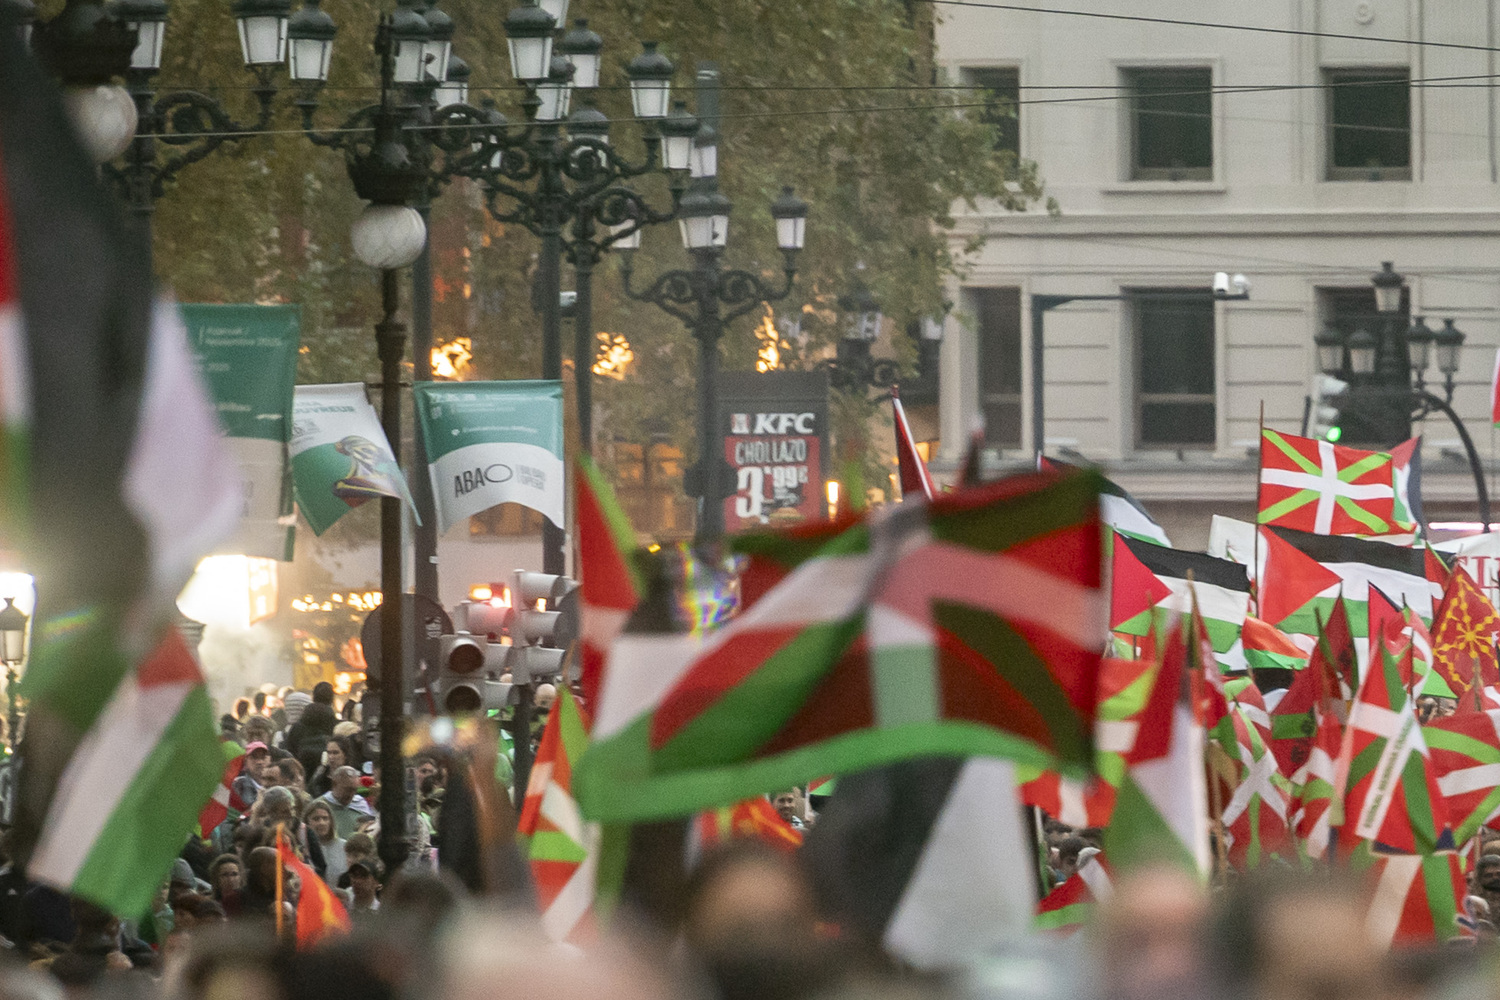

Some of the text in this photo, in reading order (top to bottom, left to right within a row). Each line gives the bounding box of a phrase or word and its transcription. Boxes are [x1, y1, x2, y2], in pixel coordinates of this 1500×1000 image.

[753, 412, 816, 434] KFC
[735, 439, 807, 465] CHOLLAZO
[453, 463, 513, 498] ABAO
